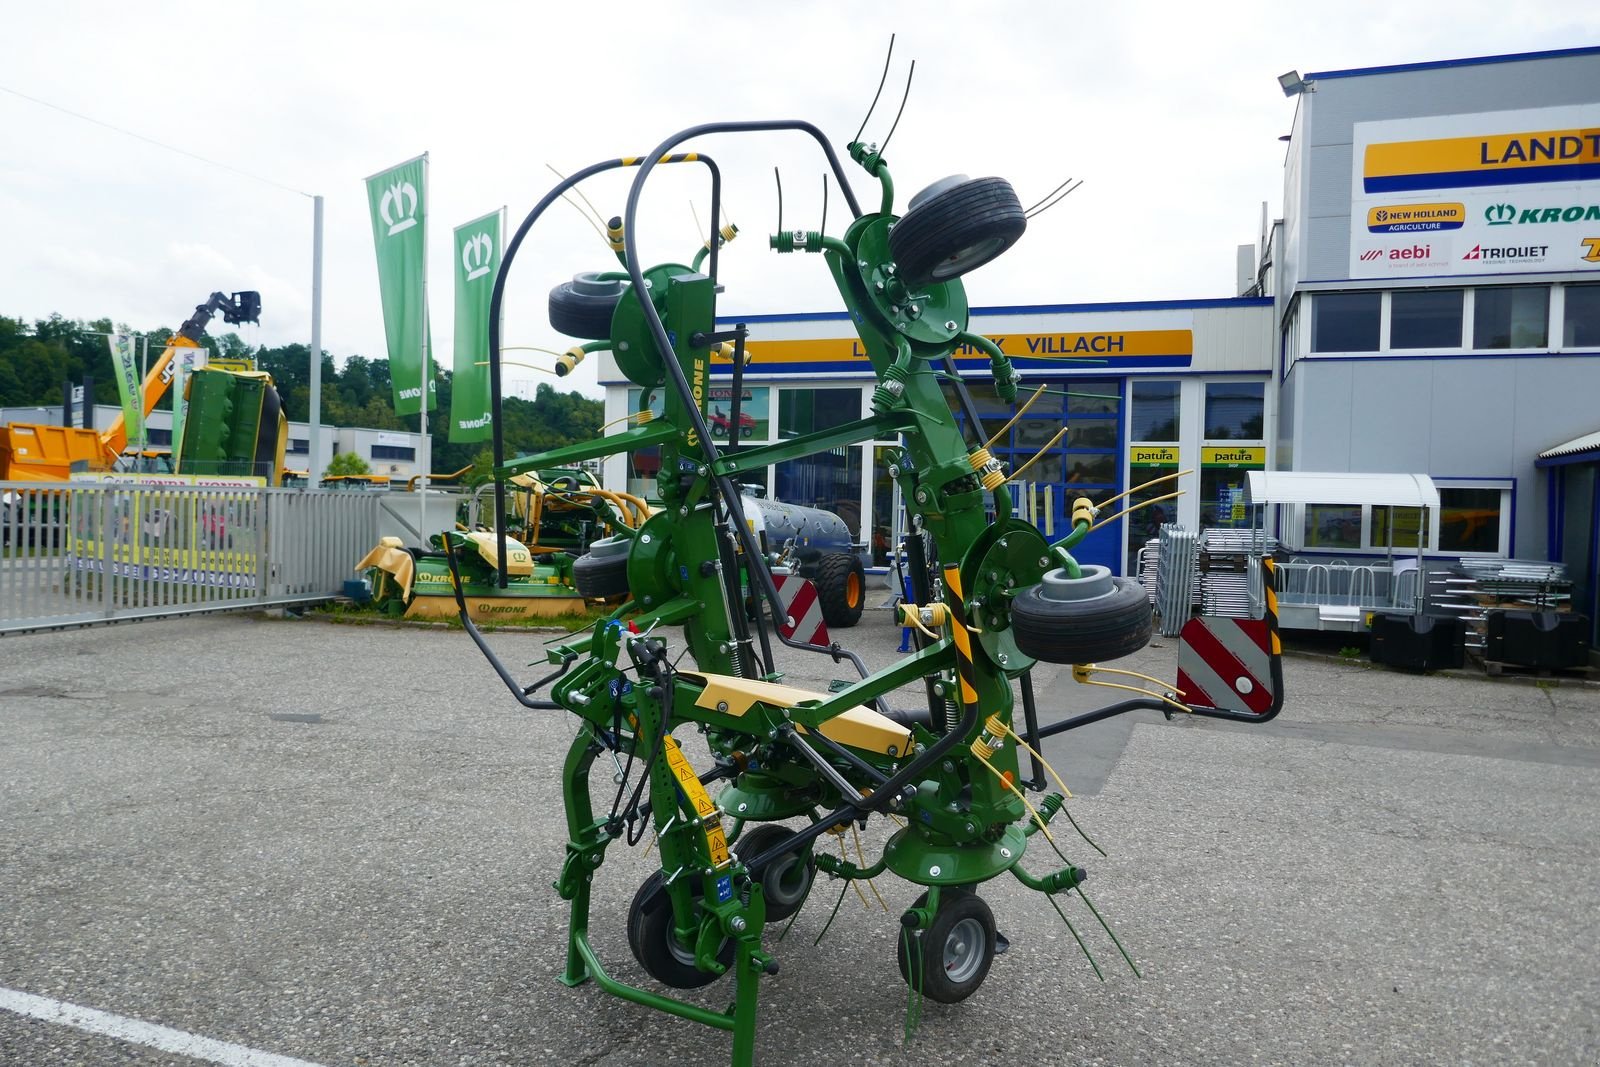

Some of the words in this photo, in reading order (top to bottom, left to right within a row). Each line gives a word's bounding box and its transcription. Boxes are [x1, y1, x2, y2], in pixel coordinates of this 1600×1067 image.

[1390, 211, 1411, 220] NEW
[1413, 209, 1457, 218] HOLLAND
[1389, 223, 1441, 231] AGRICULTURE
[1389, 244, 1430, 260] aebi
[1481, 246, 1548, 259] TRIOLIET
[1026, 335, 1124, 354] VILLACH
[1137, 452, 1172, 461] patura
[1215, 452, 1252, 462] patura
[490, 606, 528, 614] KRONE
